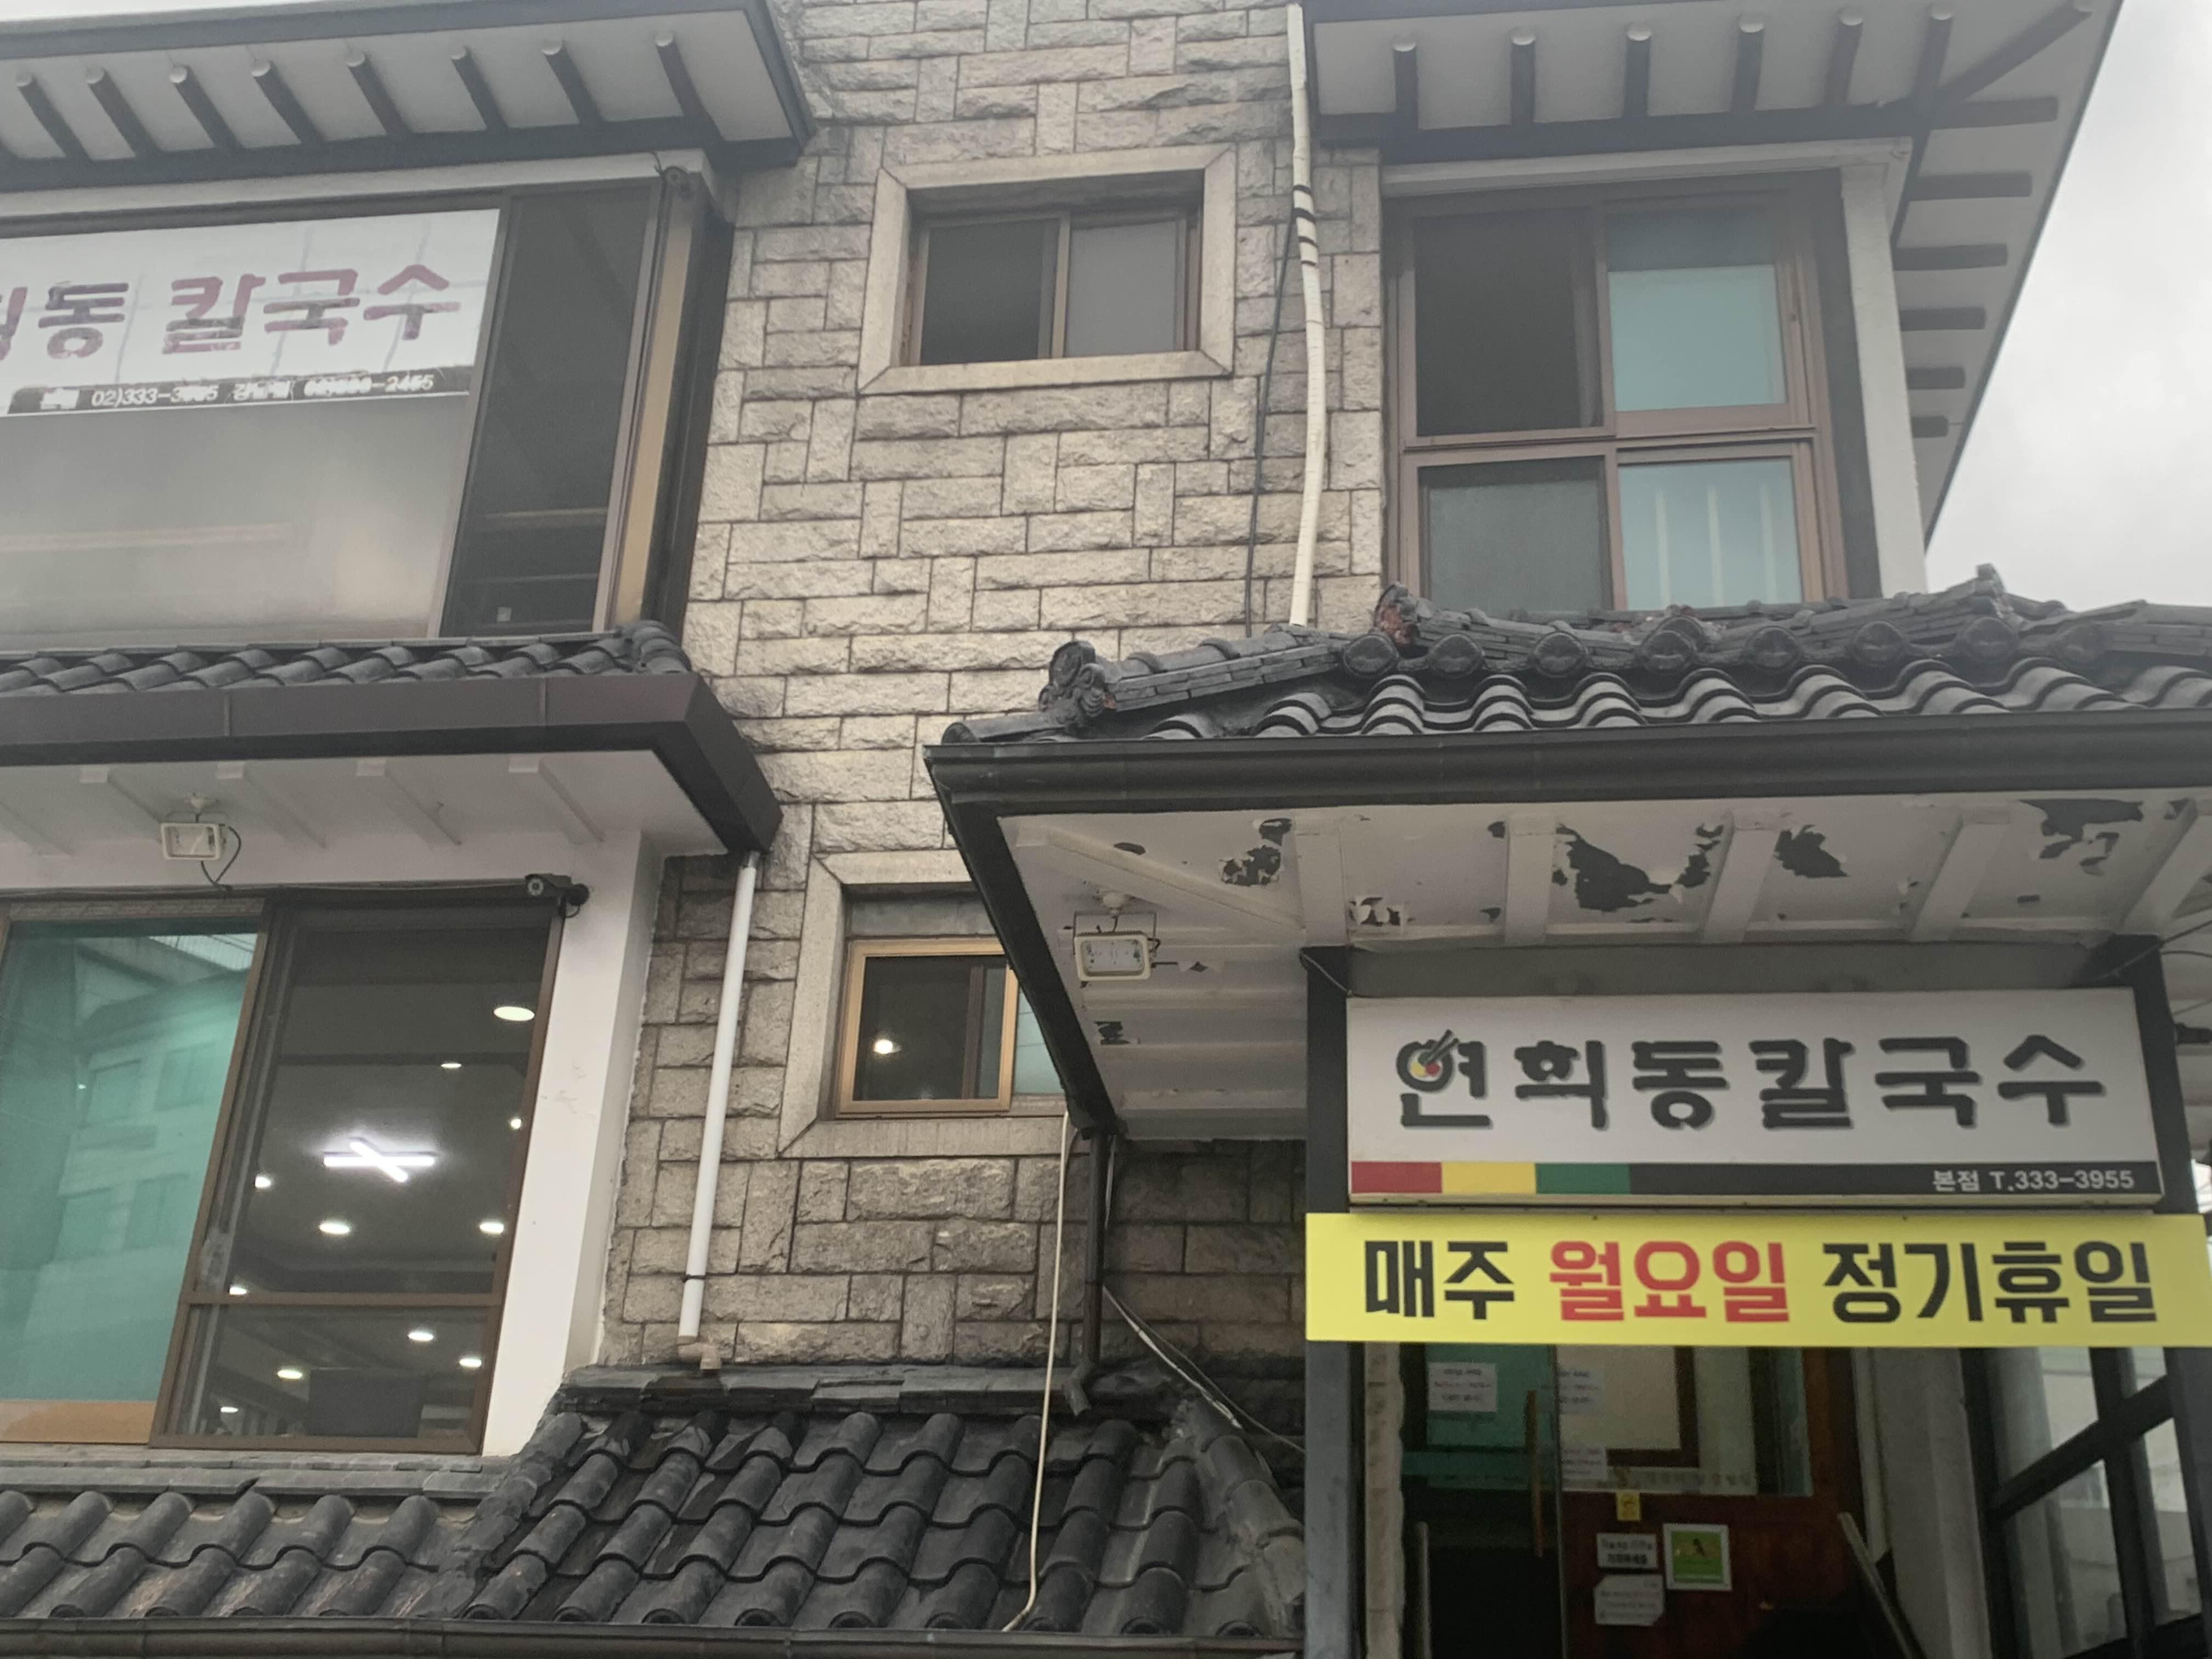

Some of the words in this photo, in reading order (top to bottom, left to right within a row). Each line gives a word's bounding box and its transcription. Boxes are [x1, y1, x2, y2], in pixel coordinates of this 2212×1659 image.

[162, 264, 461, 354] 칼국수
[1396, 1031, 2106, 1130] 연희동칼국수
[1933, 1170, 1980, 1192] 본점
[1989, 1170, 2135, 1192] T.333-3955
[1364, 1240, 1515, 1321] 매주
[1549, 1240, 1790, 1323] 월요일
[1822, 1240, 2158, 1323] 정기휴일
